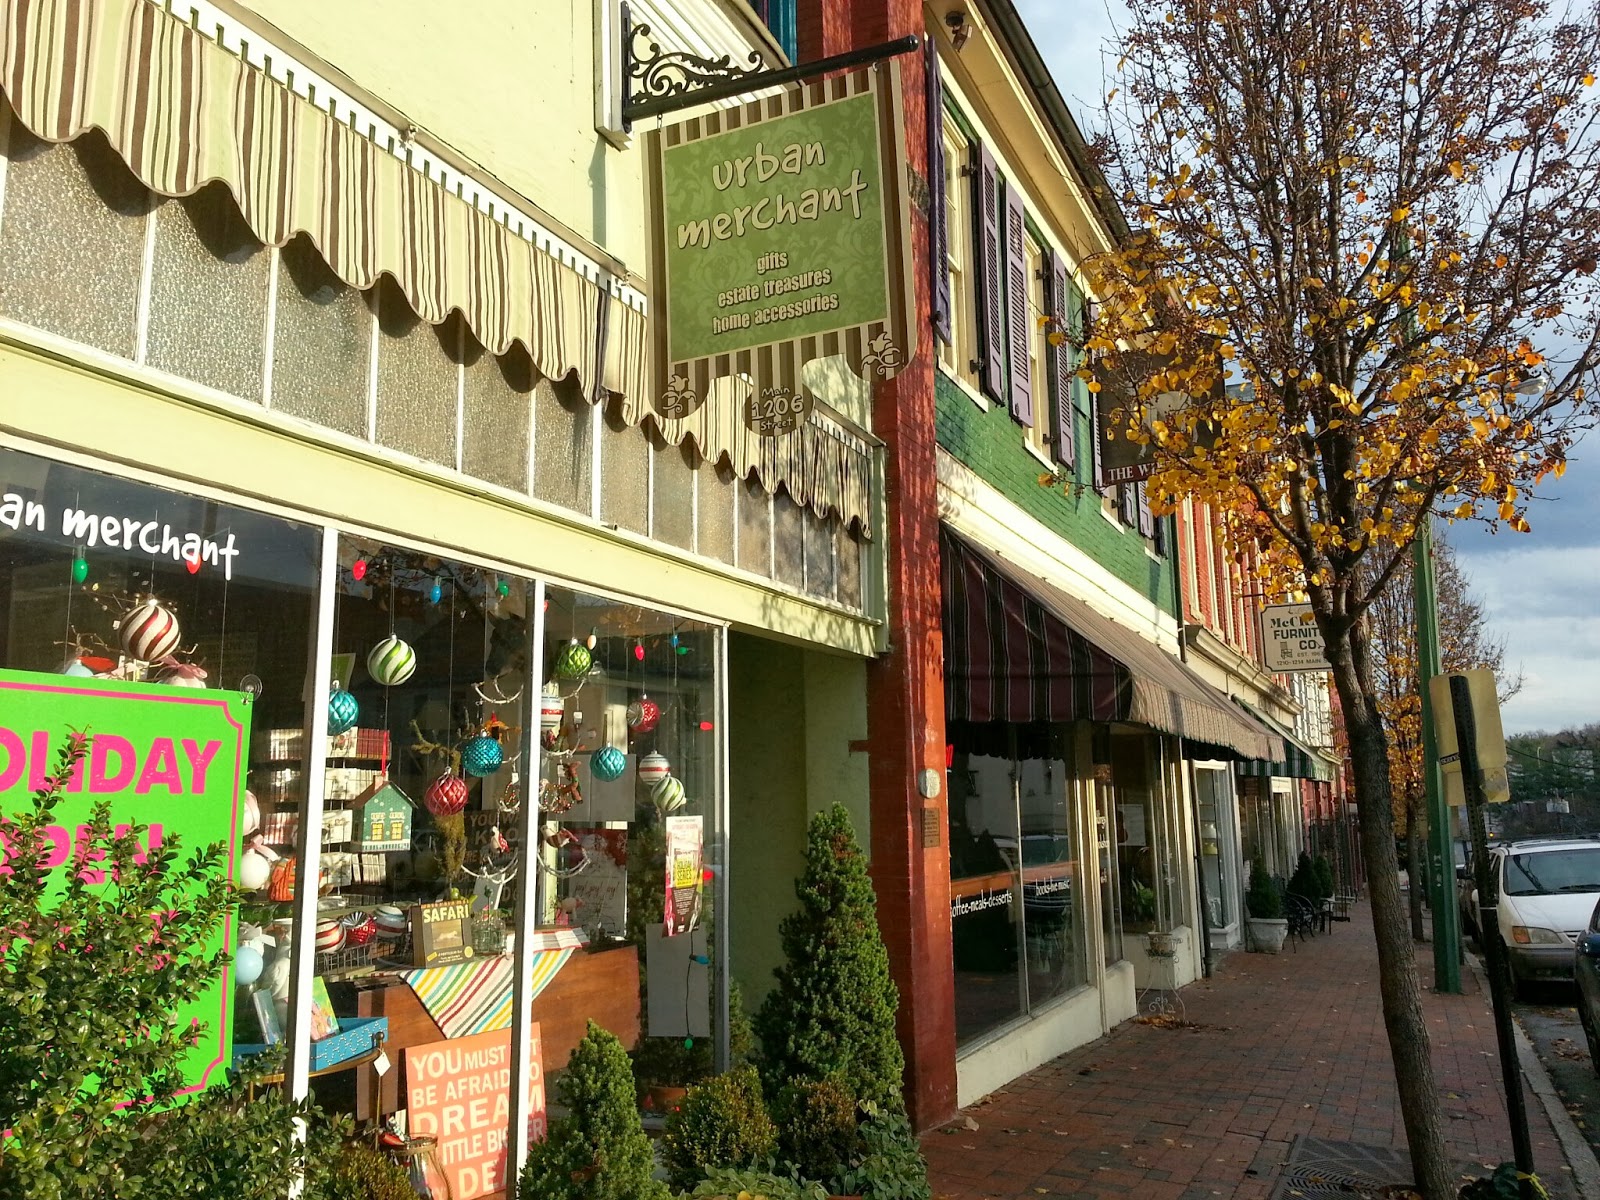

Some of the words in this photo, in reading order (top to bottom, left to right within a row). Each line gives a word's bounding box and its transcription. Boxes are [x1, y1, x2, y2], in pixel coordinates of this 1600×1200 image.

[712, 141, 825, 191] urban
[677, 169, 868, 249] merchant
[757, 251, 788, 275] gifts
[717, 284, 760, 308] estate
[763, 268, 832, 297] treasures
[712, 313, 751, 335] home
[754, 293, 839, 325] accessories
[751, 394, 804, 420] 1206
[761, 385, 790, 397] Main
[760, 416, 793, 431] Street
[1108, 466, 1134, 481] THE
[62, 507, 240, 581] merchant
[423, 903, 470, 924] SAFARI
[410, 1047, 462, 1082] YOU
[464, 1045, 506, 1071] MUST
[412, 1085, 438, 1109] BE
[445, 1068, 511, 1102] AFRAID
[442, 1134, 483, 1166] ITTLE
